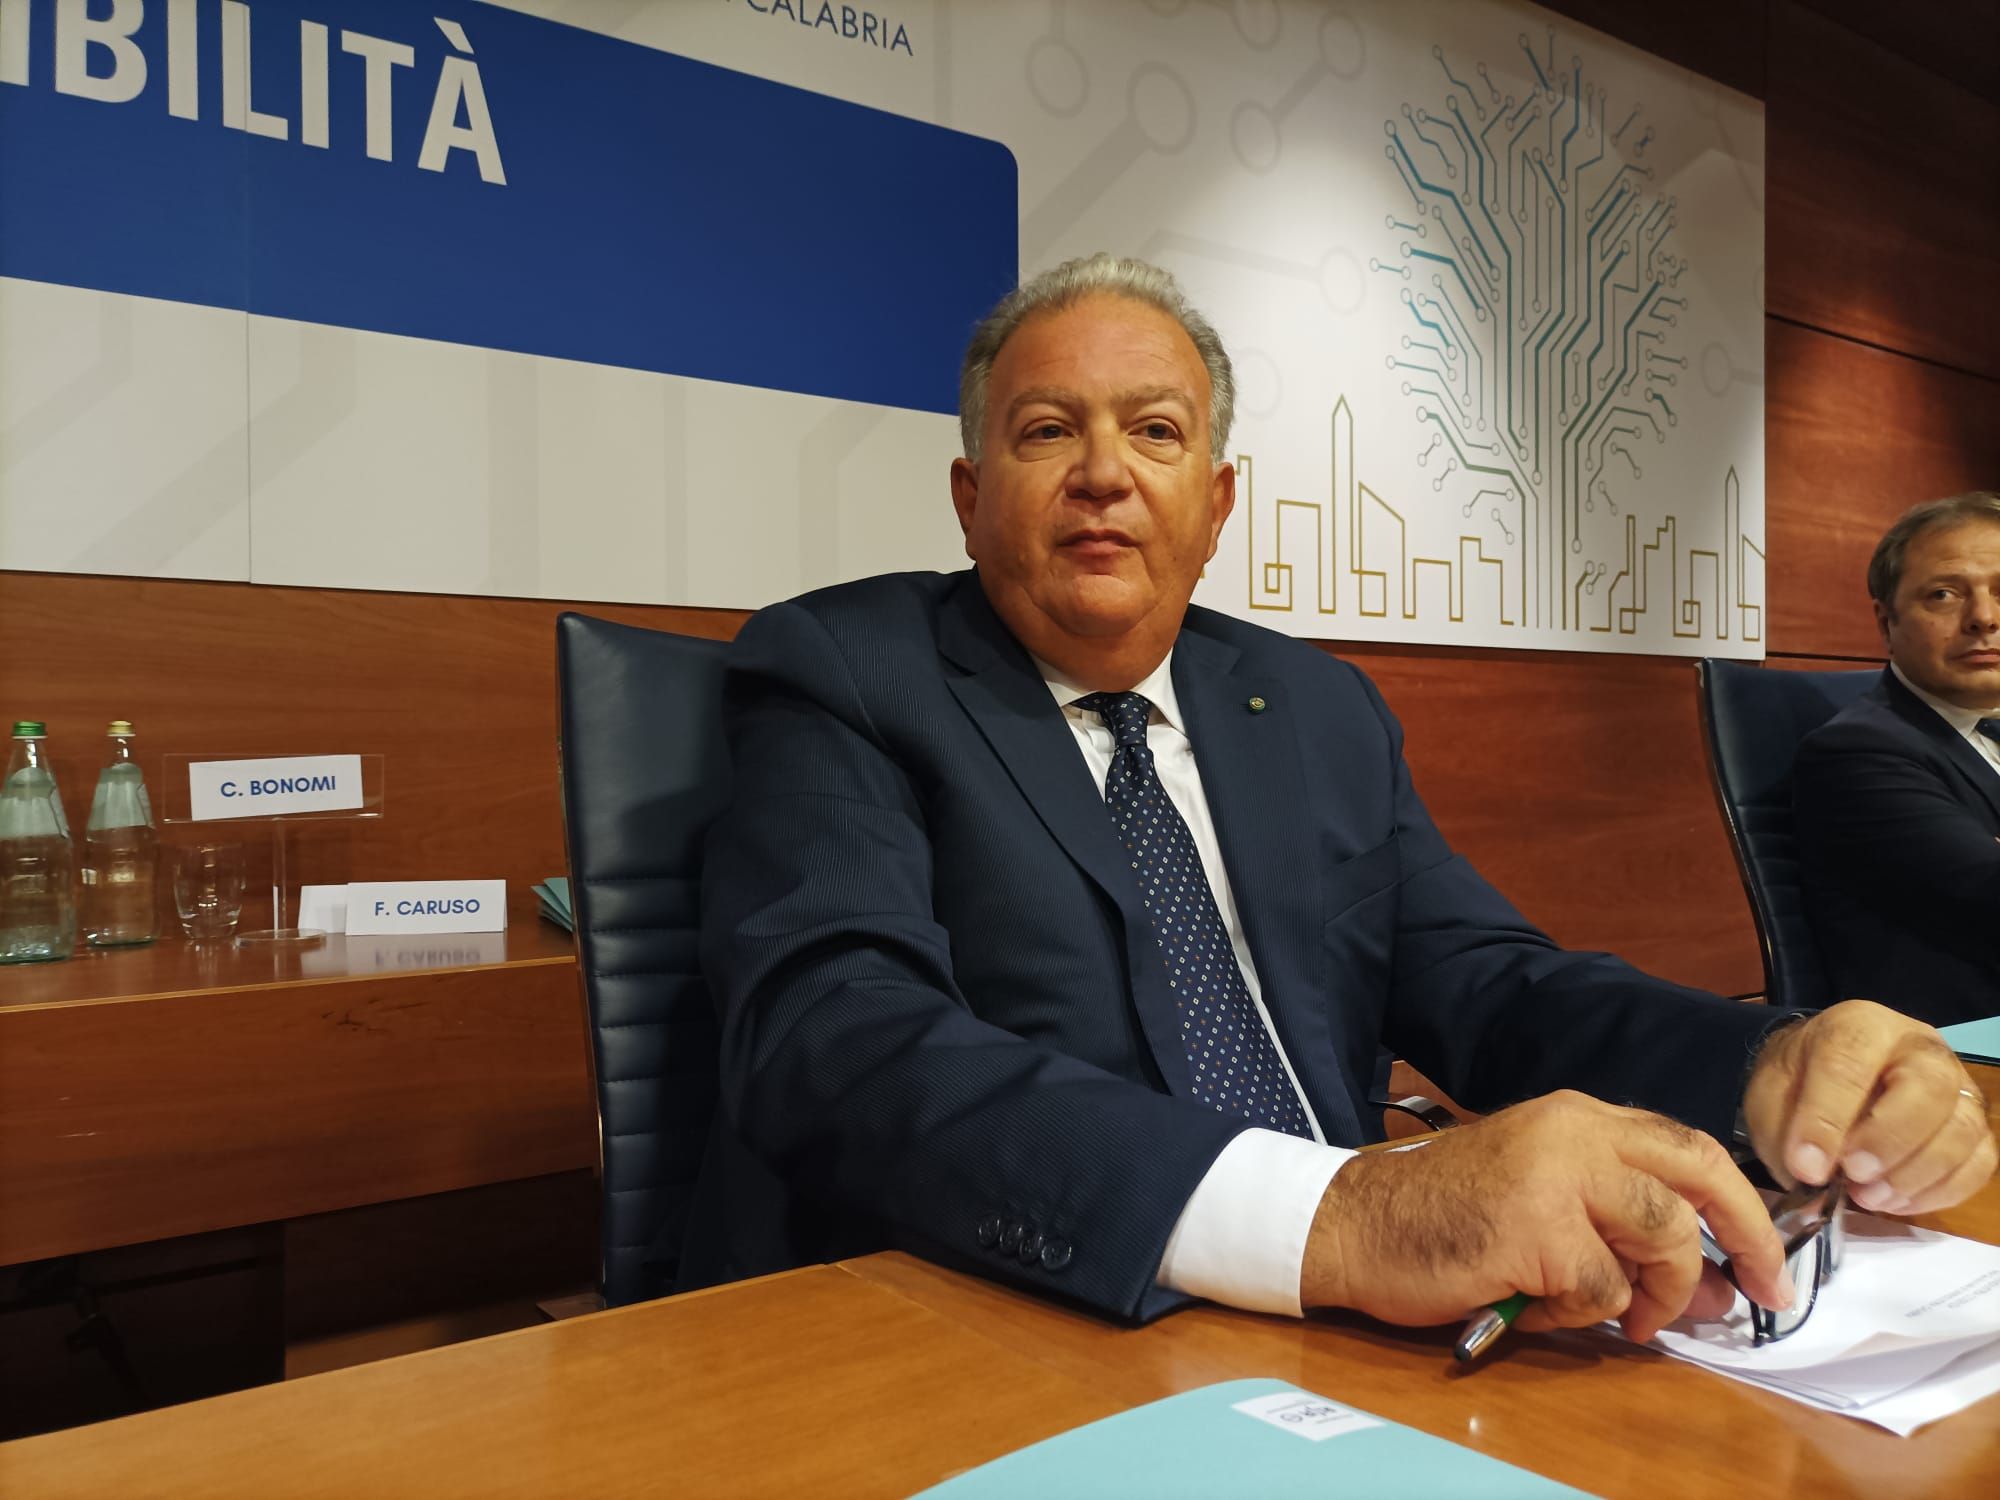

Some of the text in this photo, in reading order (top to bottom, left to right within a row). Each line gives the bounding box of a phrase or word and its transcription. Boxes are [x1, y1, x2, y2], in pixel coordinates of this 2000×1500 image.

[220, 775, 337, 798] C. BONOMI
[375, 899, 480, 916] F. CARUSO
